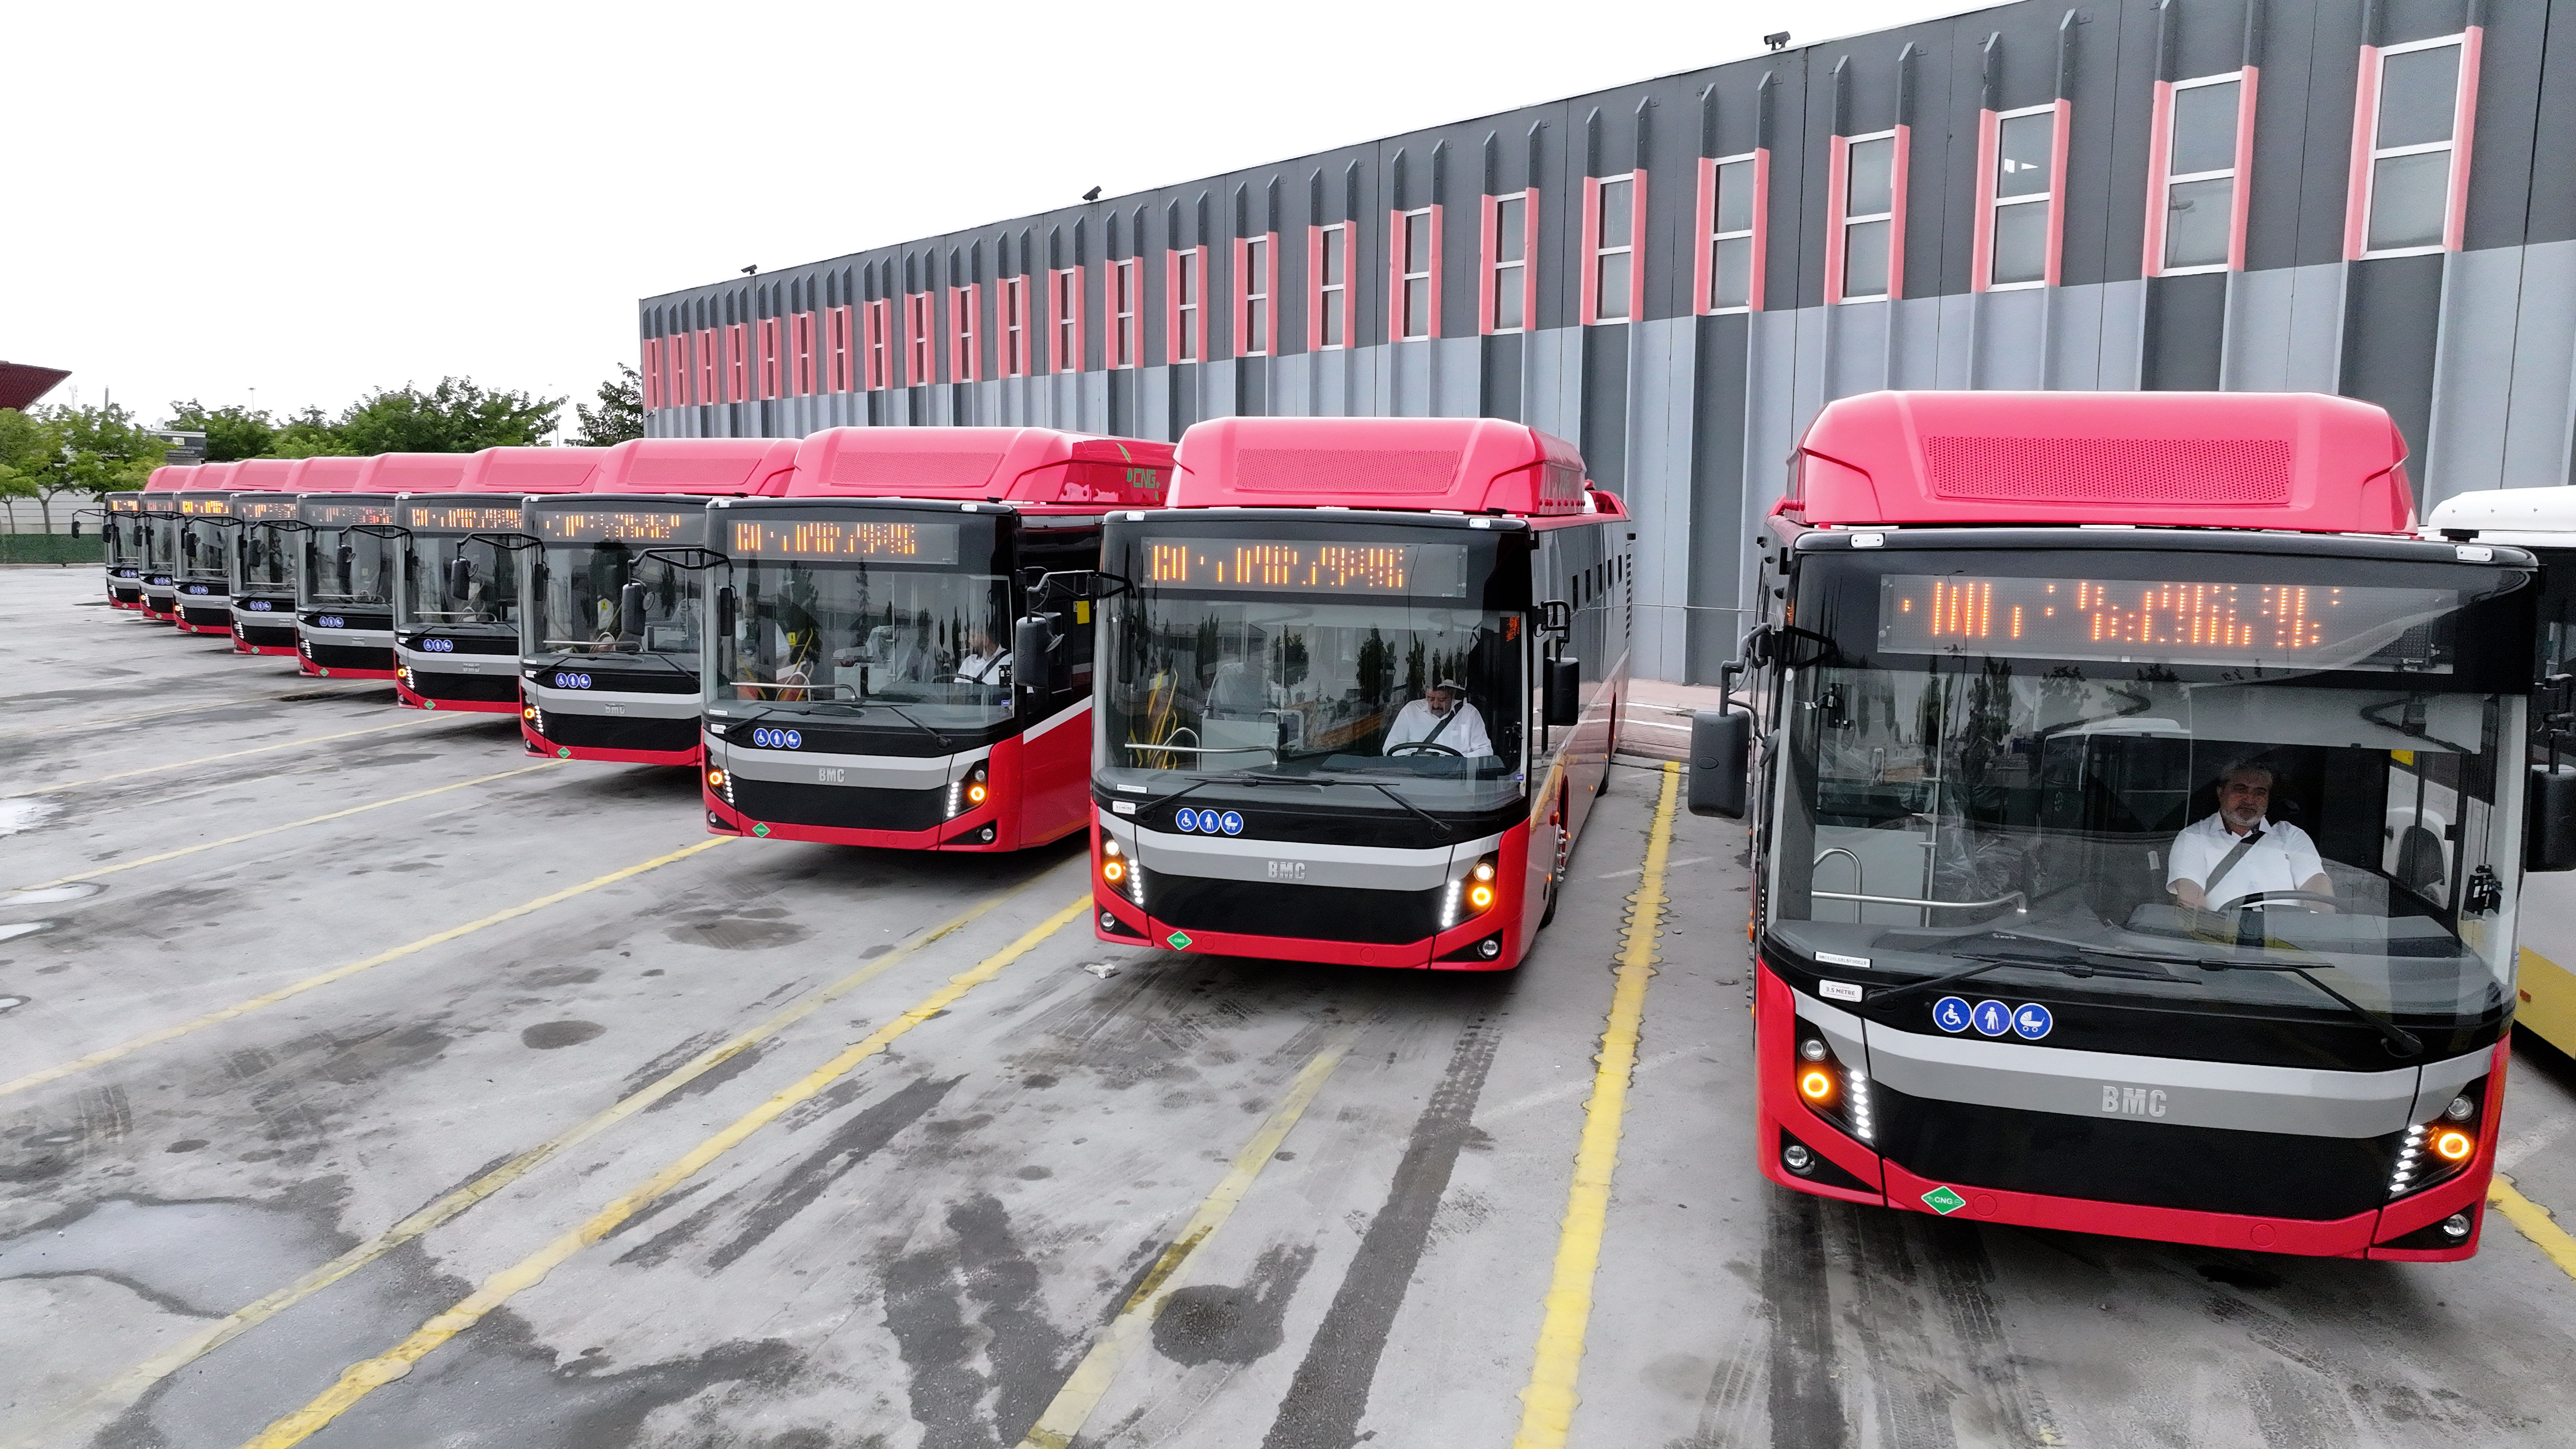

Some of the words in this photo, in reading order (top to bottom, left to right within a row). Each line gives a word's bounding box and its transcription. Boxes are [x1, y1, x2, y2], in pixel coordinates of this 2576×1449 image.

[1133, 468, 1156, 488] CNG
[819, 768, 845, 783] BMC
[1268, 861, 1305, 881] BMC
[2102, 1086, 2167, 1118] BMC
[1934, 1196, 1953, 1205] CNG
